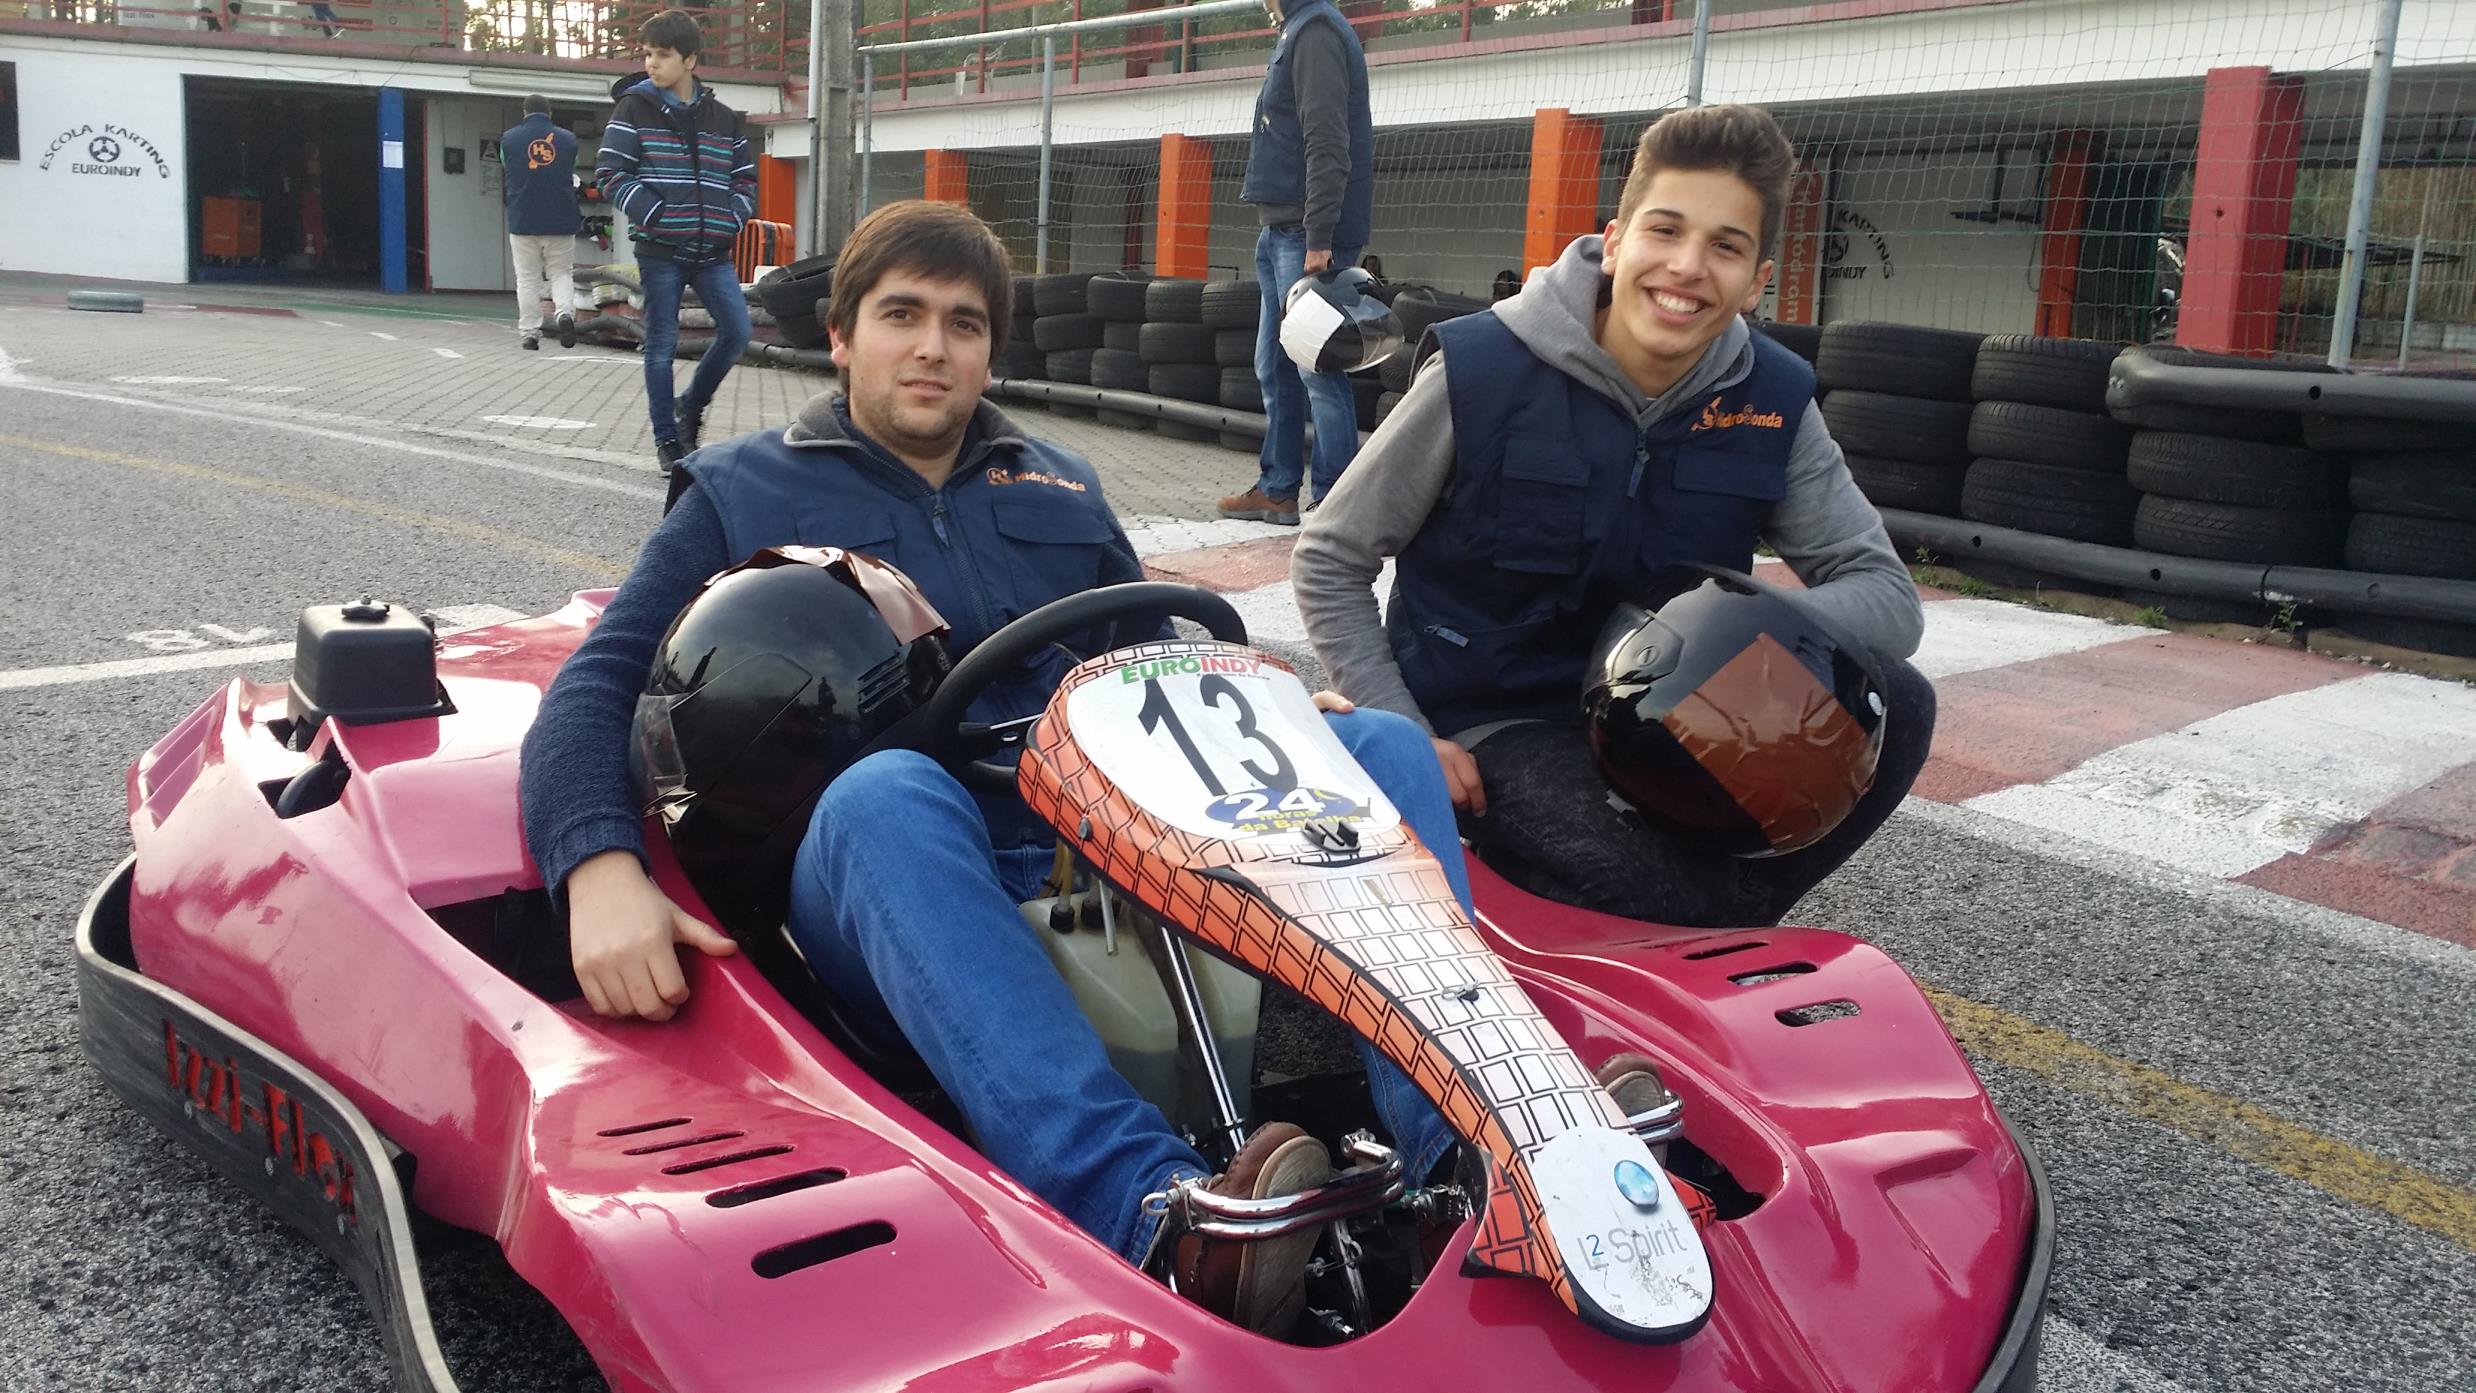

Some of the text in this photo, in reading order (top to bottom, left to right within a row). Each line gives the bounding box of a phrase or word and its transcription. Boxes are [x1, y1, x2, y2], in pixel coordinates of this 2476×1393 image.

[40, 123, 170, 179] ESCOLA KARTING
[72, 163, 141, 177] EUROINDY
[532, 143, 554, 161] HS
[1837, 209, 1894, 279] KARTING
[1121, 655, 1263, 685] EUROINDY
[1138, 673, 1299, 797] 13
[1224, 788, 1325, 820] 24
[1608, 1219, 1688, 1265] Spirit
